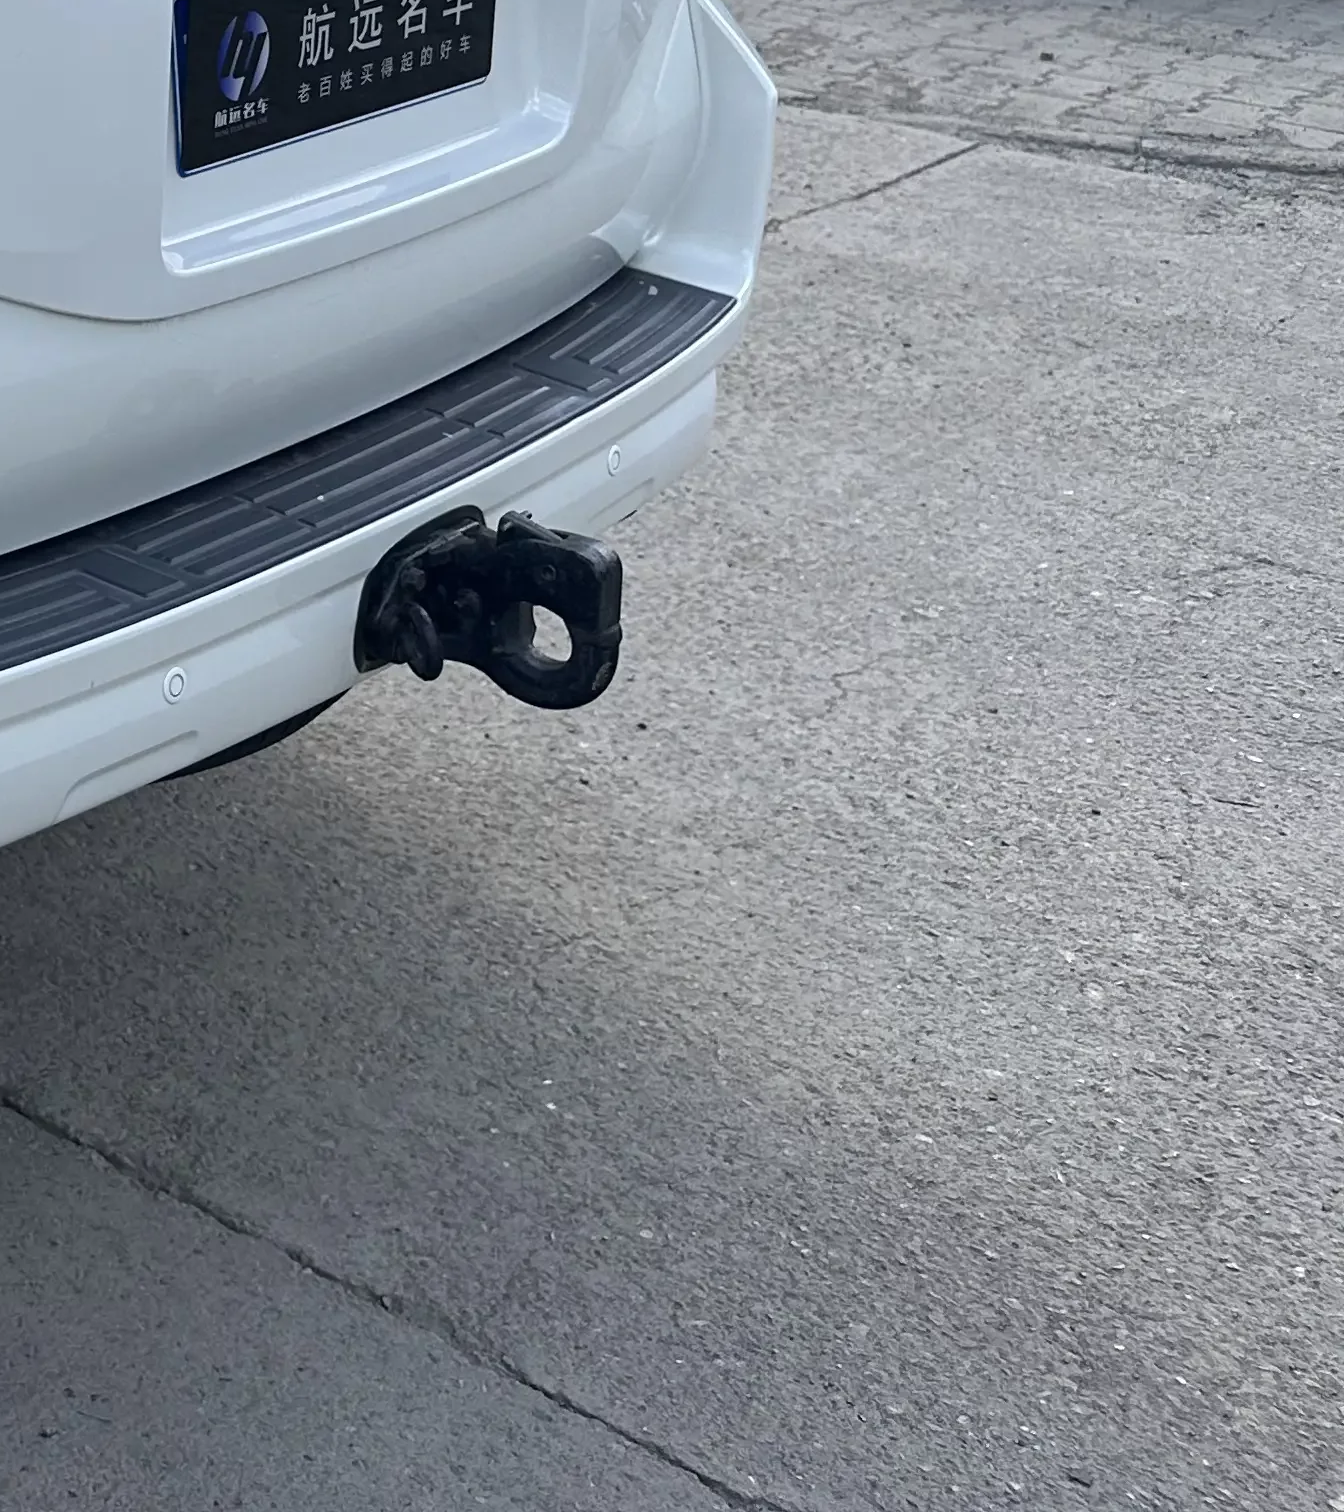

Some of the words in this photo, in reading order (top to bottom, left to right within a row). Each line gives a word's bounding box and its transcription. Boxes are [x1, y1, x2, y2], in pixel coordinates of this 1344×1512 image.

[296, 33, 473, 104] 老百姓买得起的好车
